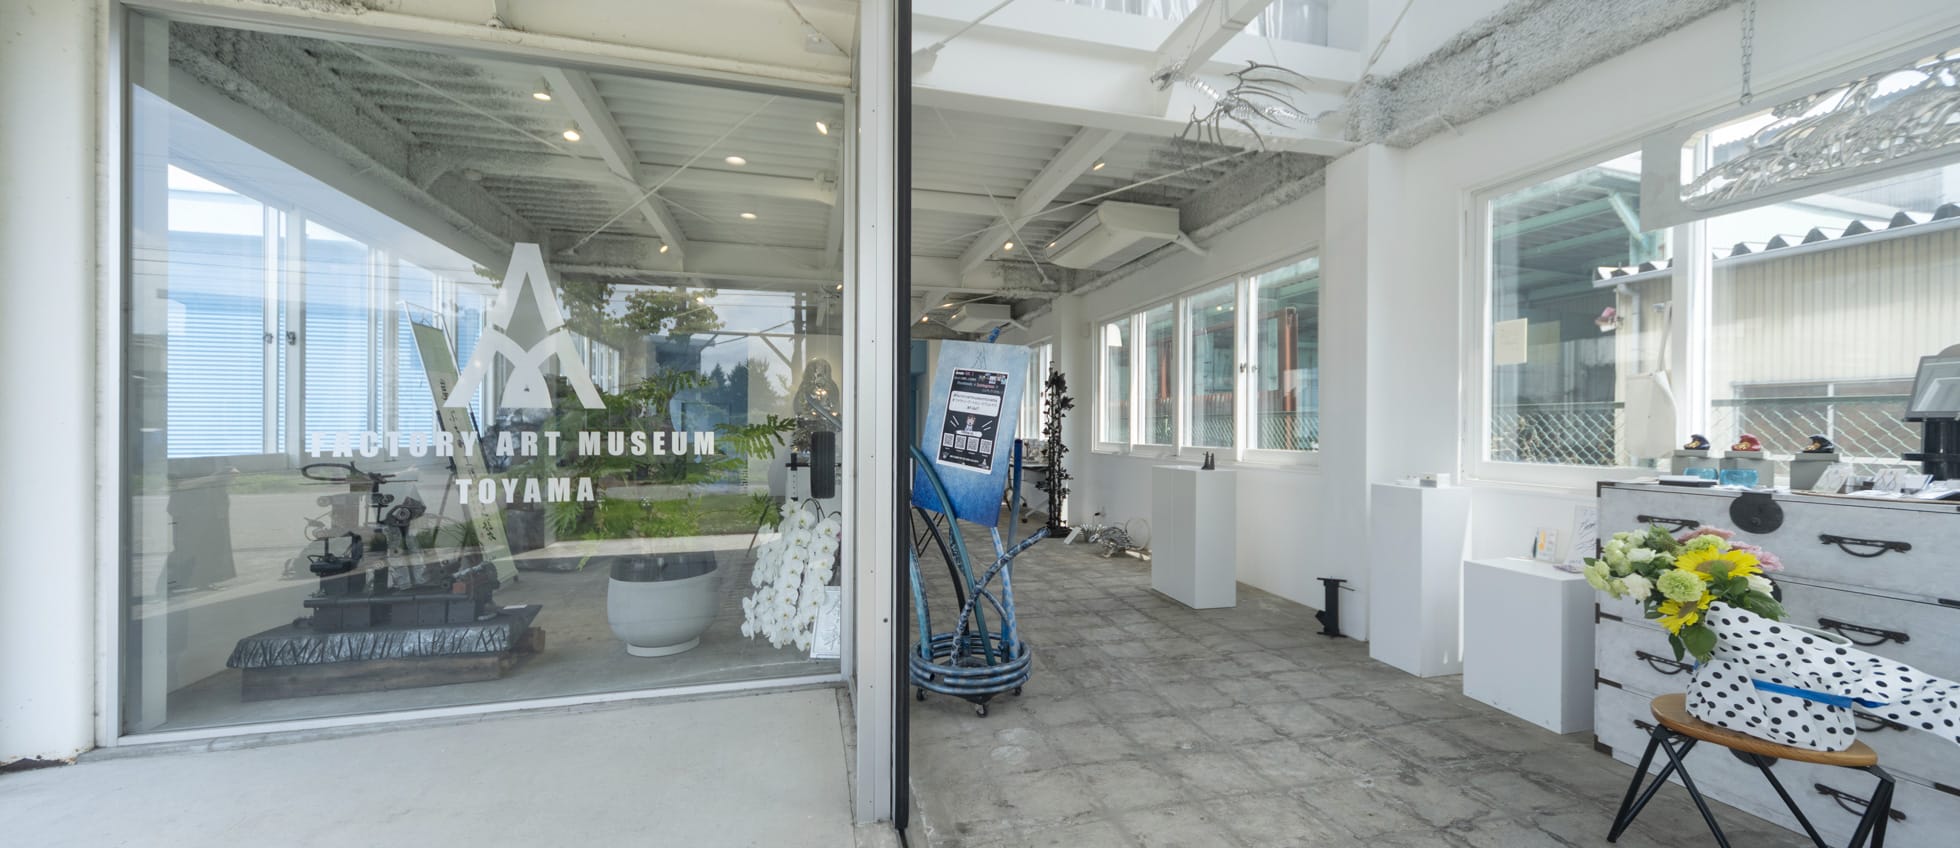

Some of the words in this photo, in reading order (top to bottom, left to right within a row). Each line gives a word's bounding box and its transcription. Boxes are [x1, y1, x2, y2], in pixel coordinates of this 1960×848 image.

[311, 431, 478, 458] FACTORY
[495, 431, 561, 457] ART
[578, 431, 715, 457] MUSEUM
[455, 476, 595, 505] TOYAMA
